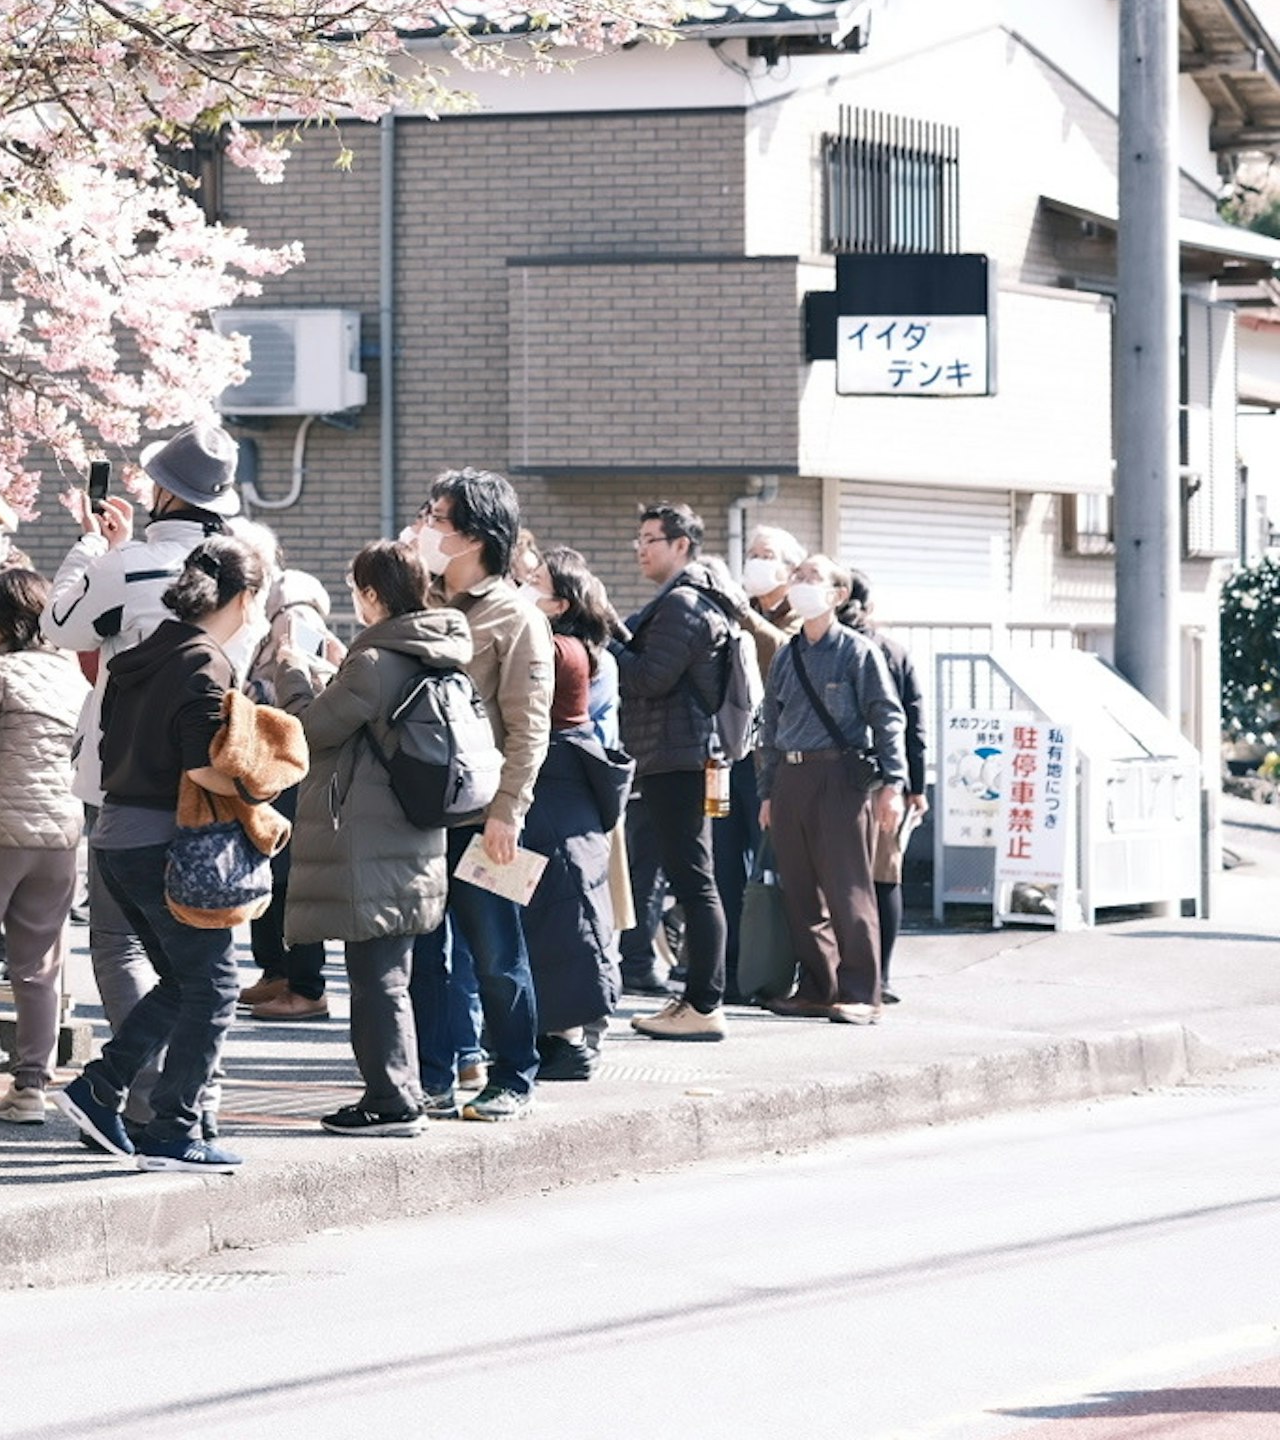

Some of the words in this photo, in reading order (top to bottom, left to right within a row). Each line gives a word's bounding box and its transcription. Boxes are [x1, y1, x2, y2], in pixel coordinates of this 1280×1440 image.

[848, 322, 930, 351] イイダ
[888, 359, 972, 388] デンキ
[949, 717, 1000, 730] 犬のフンは
[1006, 726, 1038, 859] 駐停車禁止
[1044, 728, 1064, 830] 私有地につき
